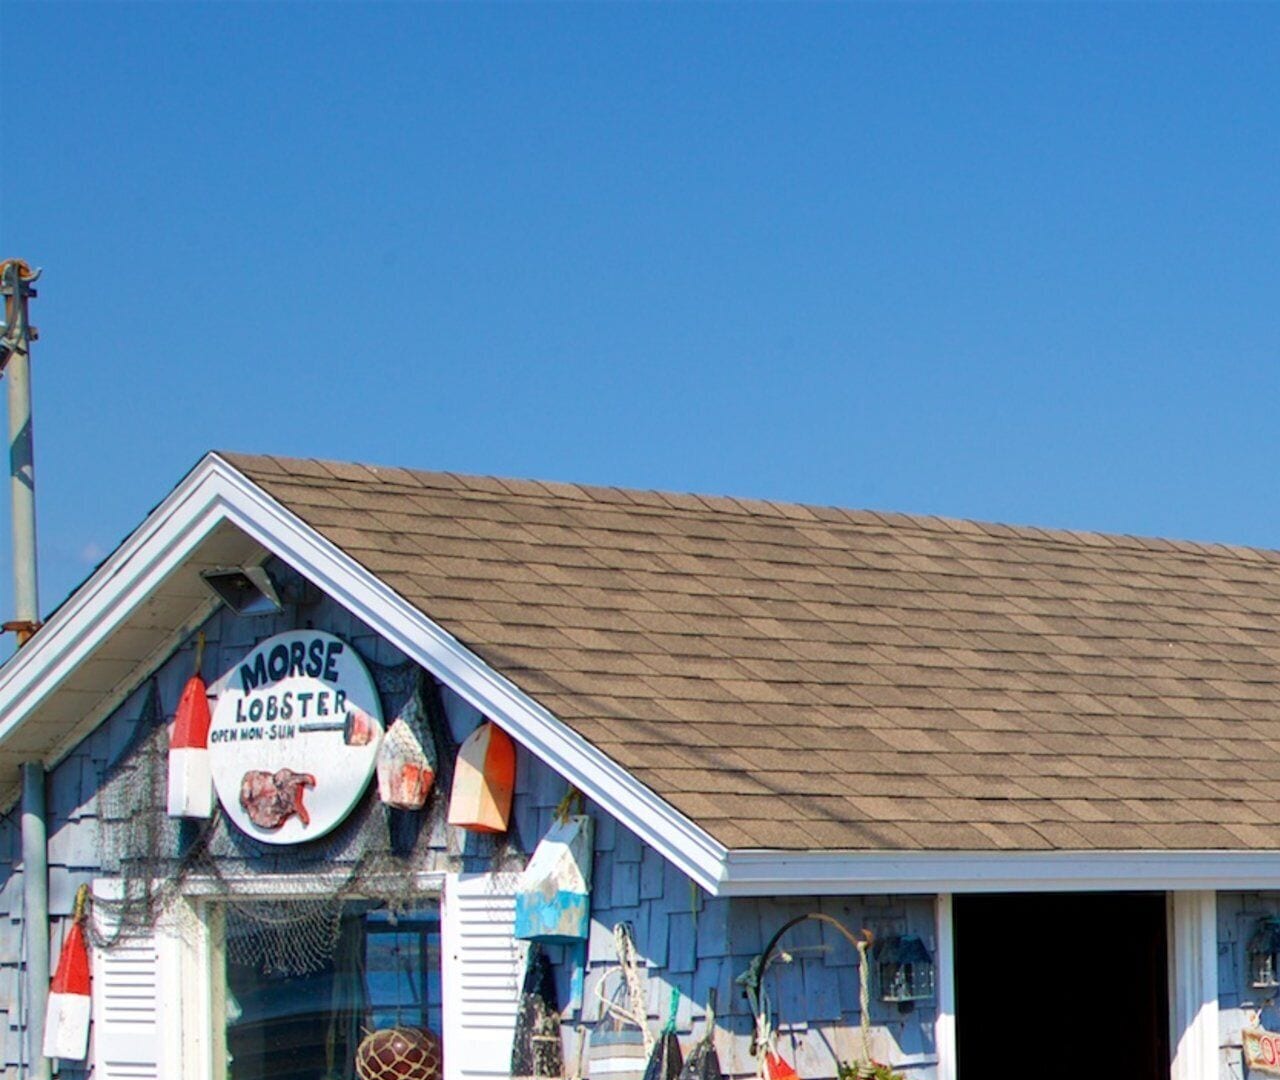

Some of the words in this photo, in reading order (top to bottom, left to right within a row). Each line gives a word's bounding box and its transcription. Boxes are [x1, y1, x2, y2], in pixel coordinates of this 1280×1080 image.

[240, 639, 344, 697] MORSE
[236, 690, 347, 723] LOBSTER
[211, 728, 238, 743] OPEN
